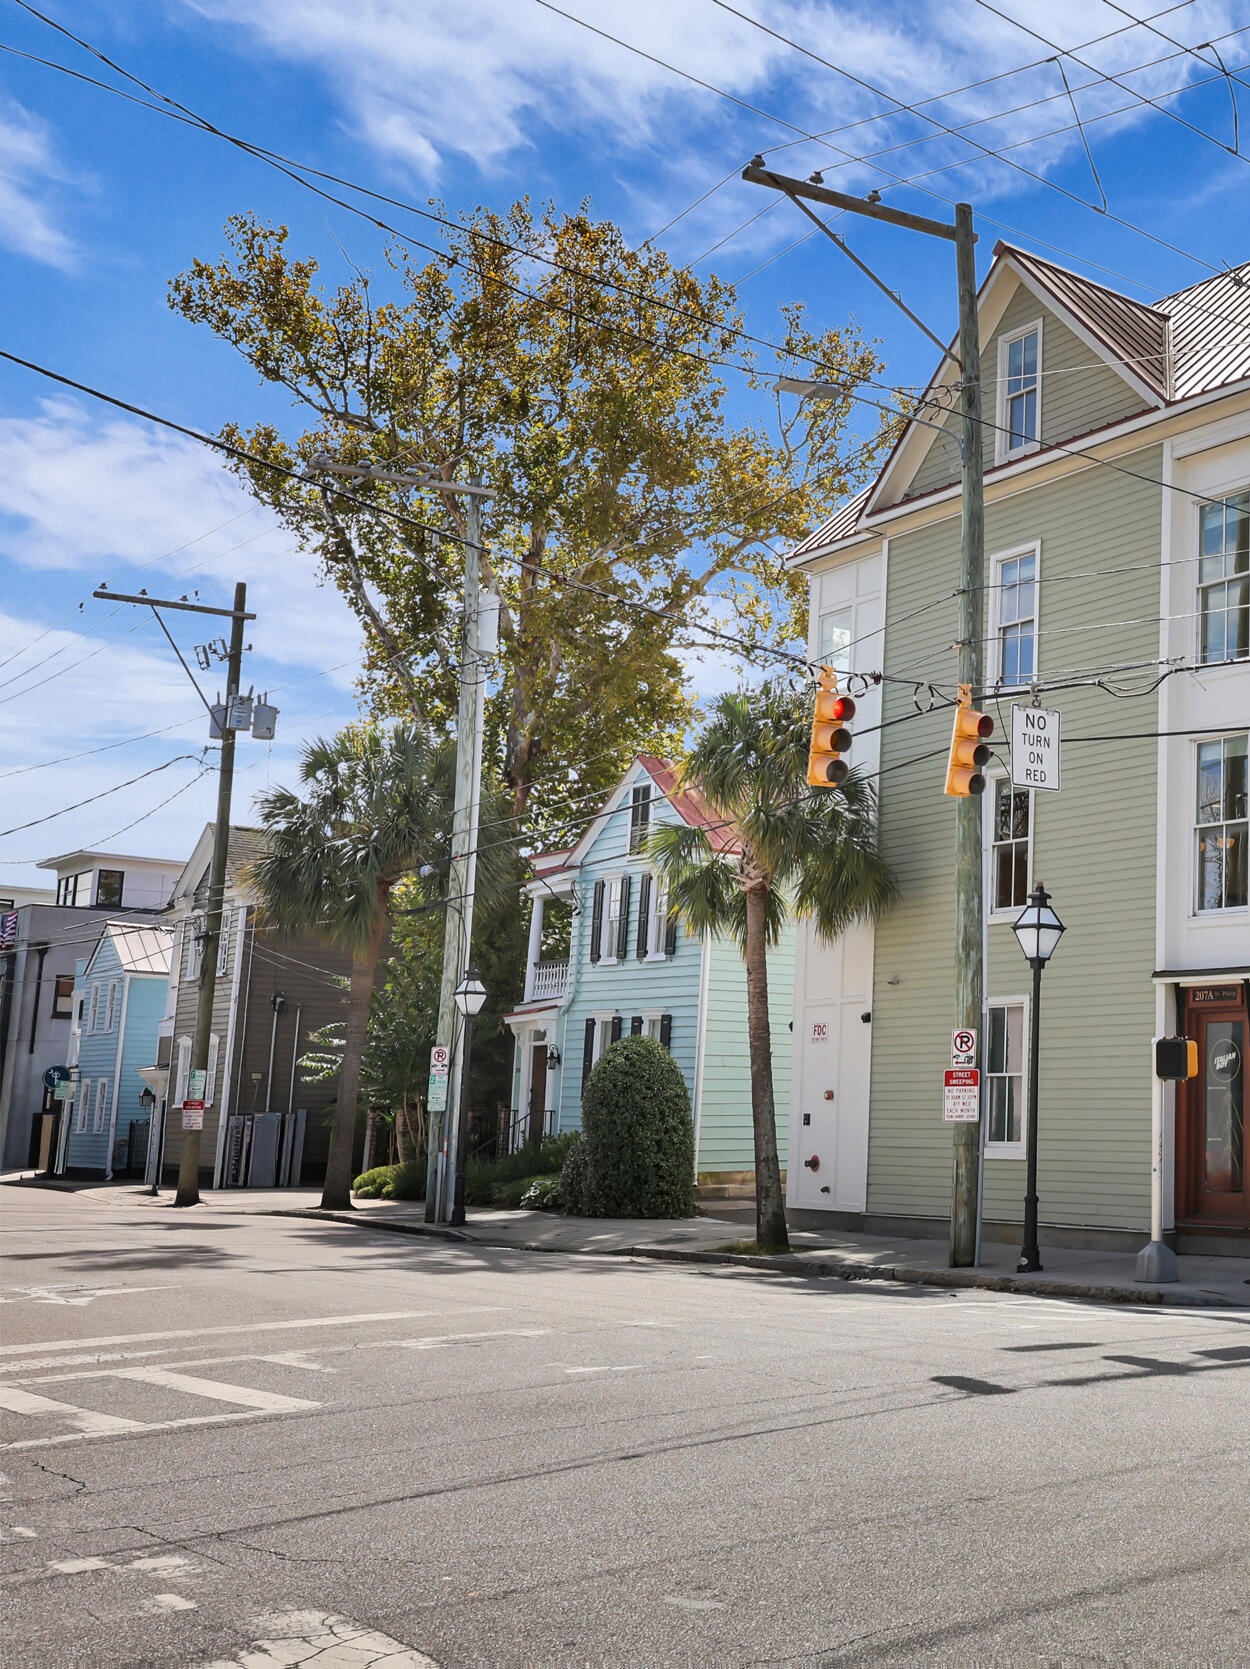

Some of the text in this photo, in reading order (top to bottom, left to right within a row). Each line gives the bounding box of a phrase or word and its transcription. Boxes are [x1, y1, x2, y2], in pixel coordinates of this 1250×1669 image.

[1026, 713, 1046, 730] NO
[1022, 733, 1050, 748] TURN
[1029, 751, 1043, 765] ON
[1025, 768, 1046, 782] RED
[1195, 990, 1214, 1000] 207A
[813, 1024, 827, 1036] FDC
[1214, 1051, 1237, 1065] ITALIAN
